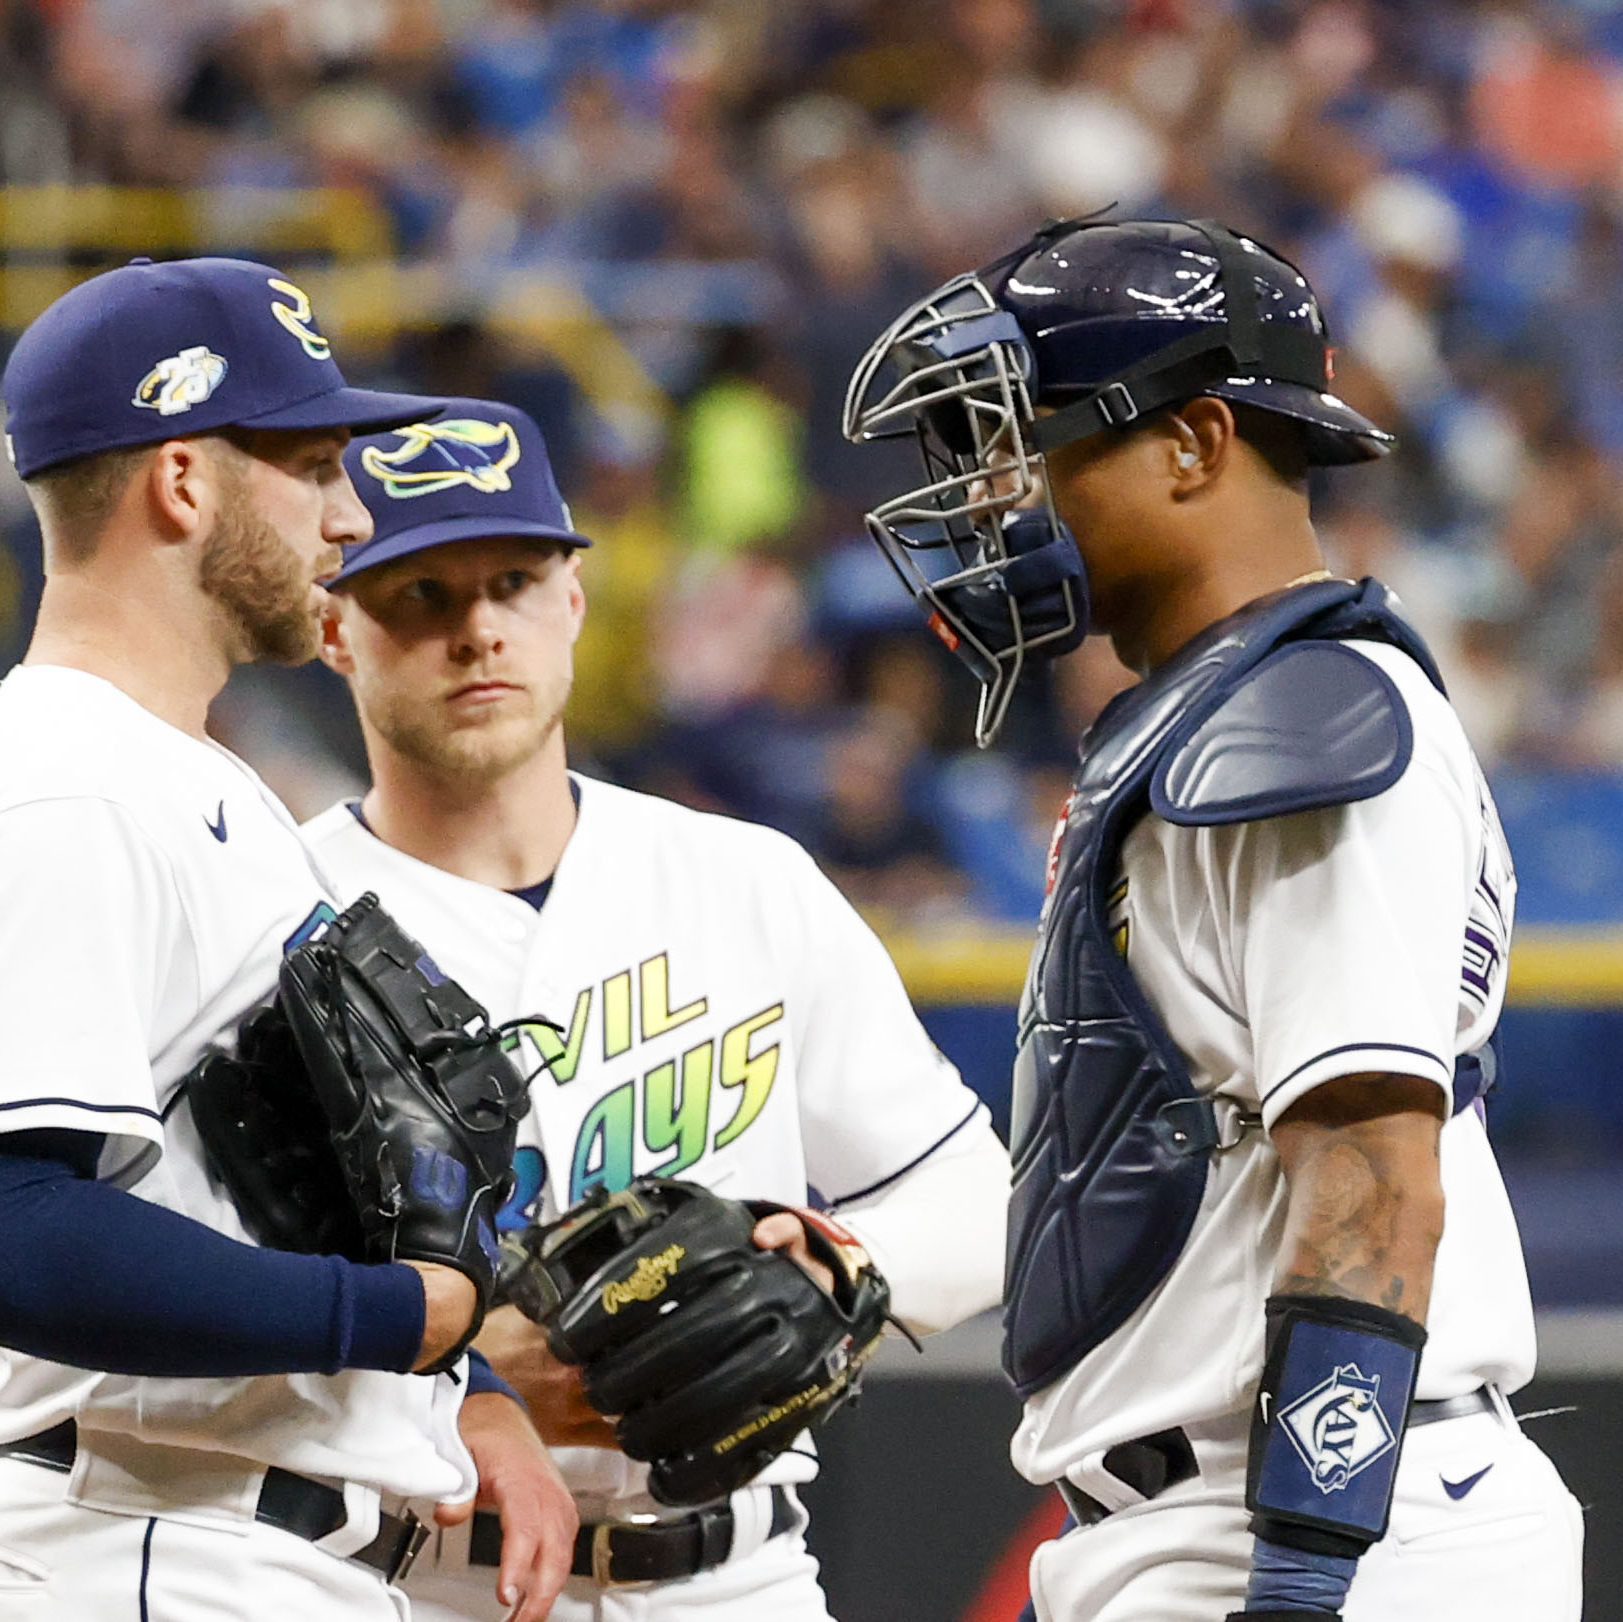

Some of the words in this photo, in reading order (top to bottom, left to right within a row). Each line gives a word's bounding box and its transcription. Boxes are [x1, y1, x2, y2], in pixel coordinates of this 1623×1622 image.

[158, 346, 210, 416] 25
[500, 950, 709, 1087] VIL
[1310, 1365, 1381, 1491] RAYS
